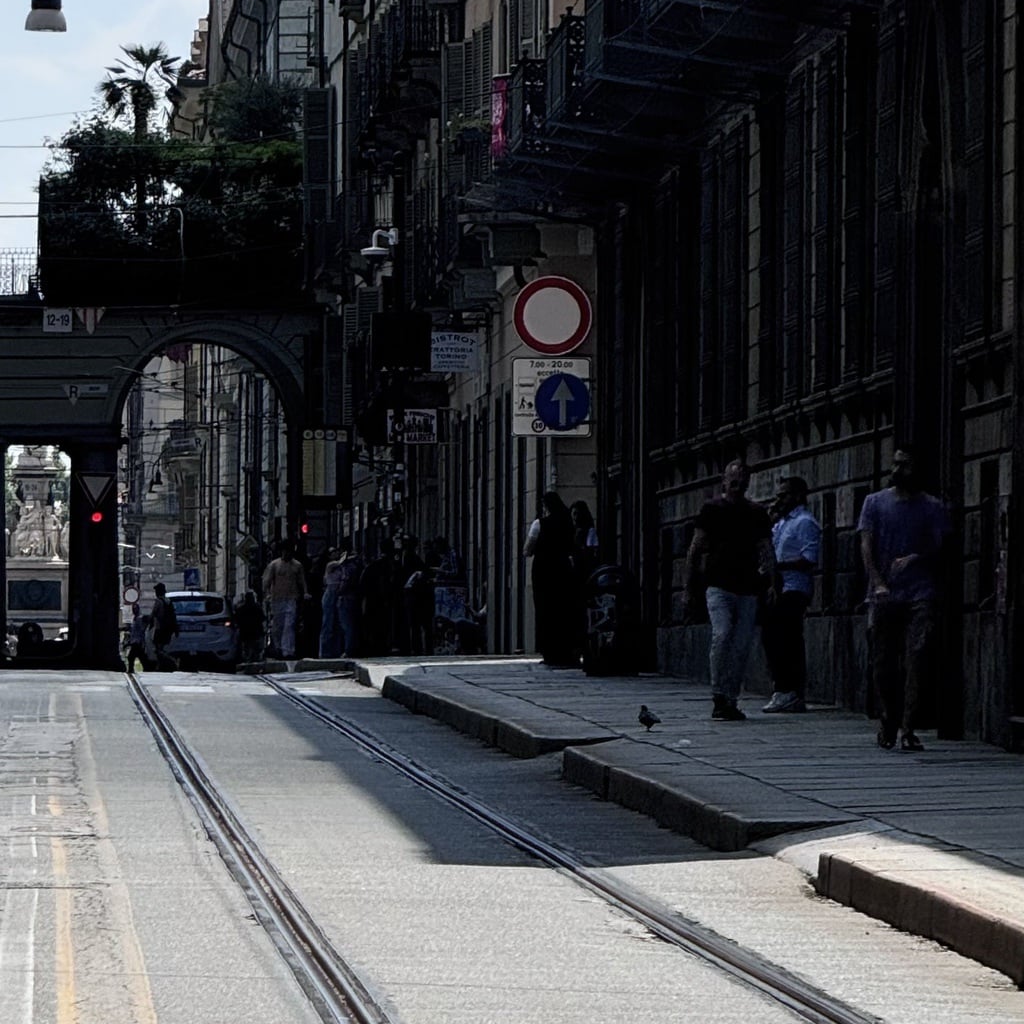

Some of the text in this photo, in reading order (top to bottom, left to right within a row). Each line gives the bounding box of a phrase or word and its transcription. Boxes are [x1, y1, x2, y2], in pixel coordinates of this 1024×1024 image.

[46, 313, 70, 326] 12-19
[529, 360, 545, 368] 7.00
[551, 360, 574, 368] 20.00
[69, 385, 79, 399] R
[195, 437, 203, 448] R
